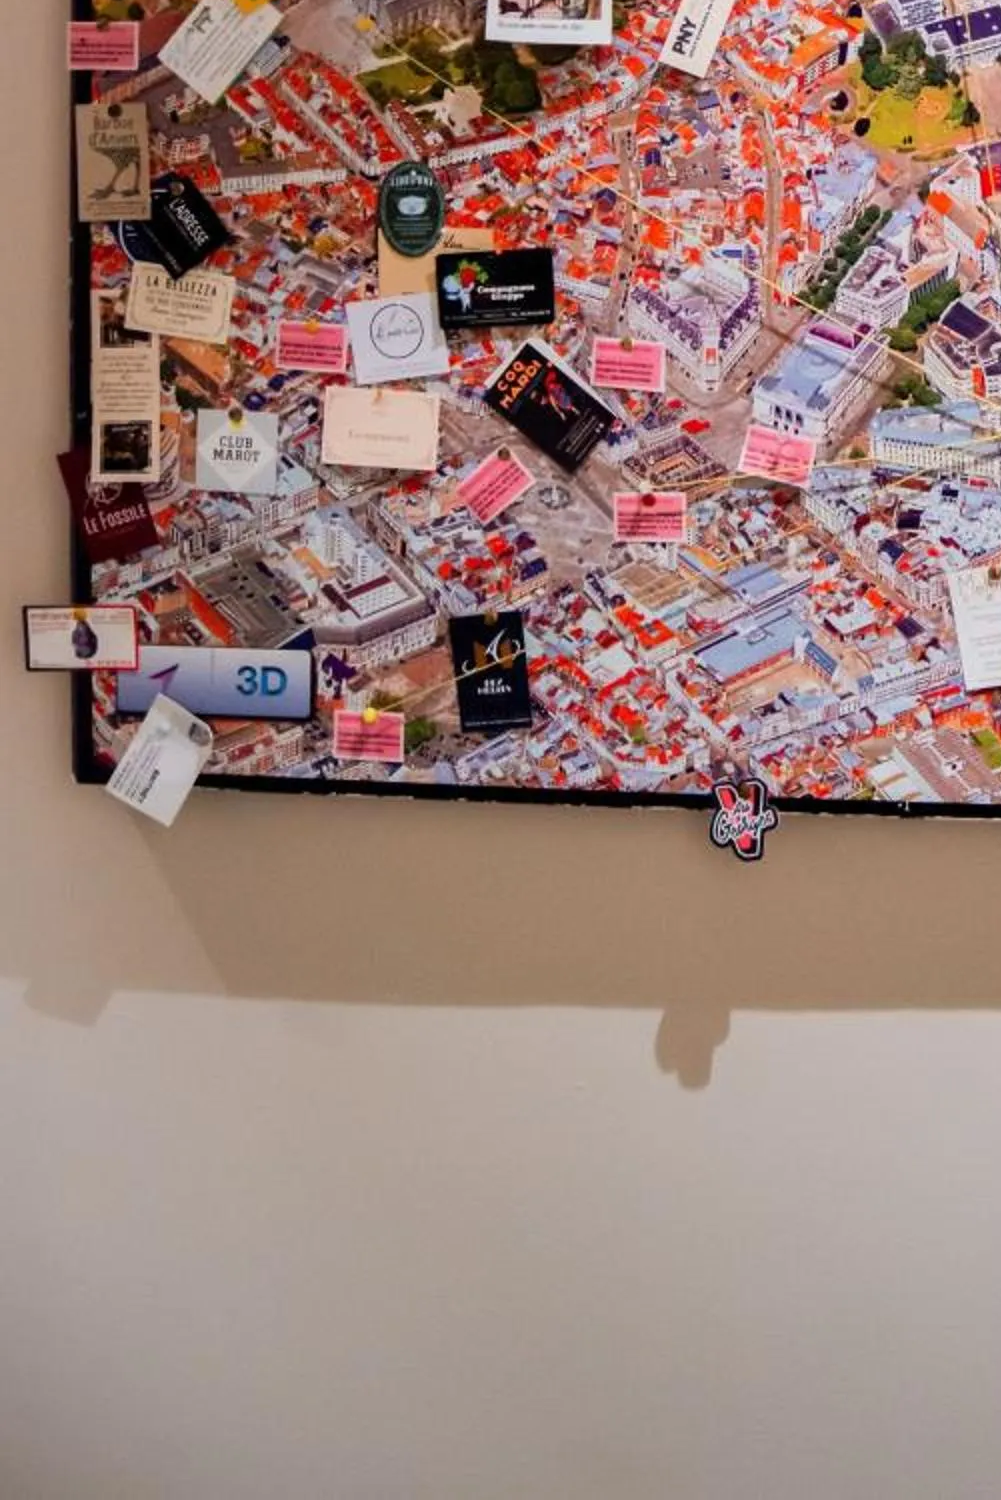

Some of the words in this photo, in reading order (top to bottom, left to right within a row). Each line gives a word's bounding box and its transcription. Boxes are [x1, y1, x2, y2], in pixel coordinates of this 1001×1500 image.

[672, 15, 698, 56] PNY
[168, 197, 211, 247] L'ADRESSE
[213, 449, 261, 463] MAROT
[219, 435, 253, 449] CLUB
[236, 664, 289, 697] 3D
